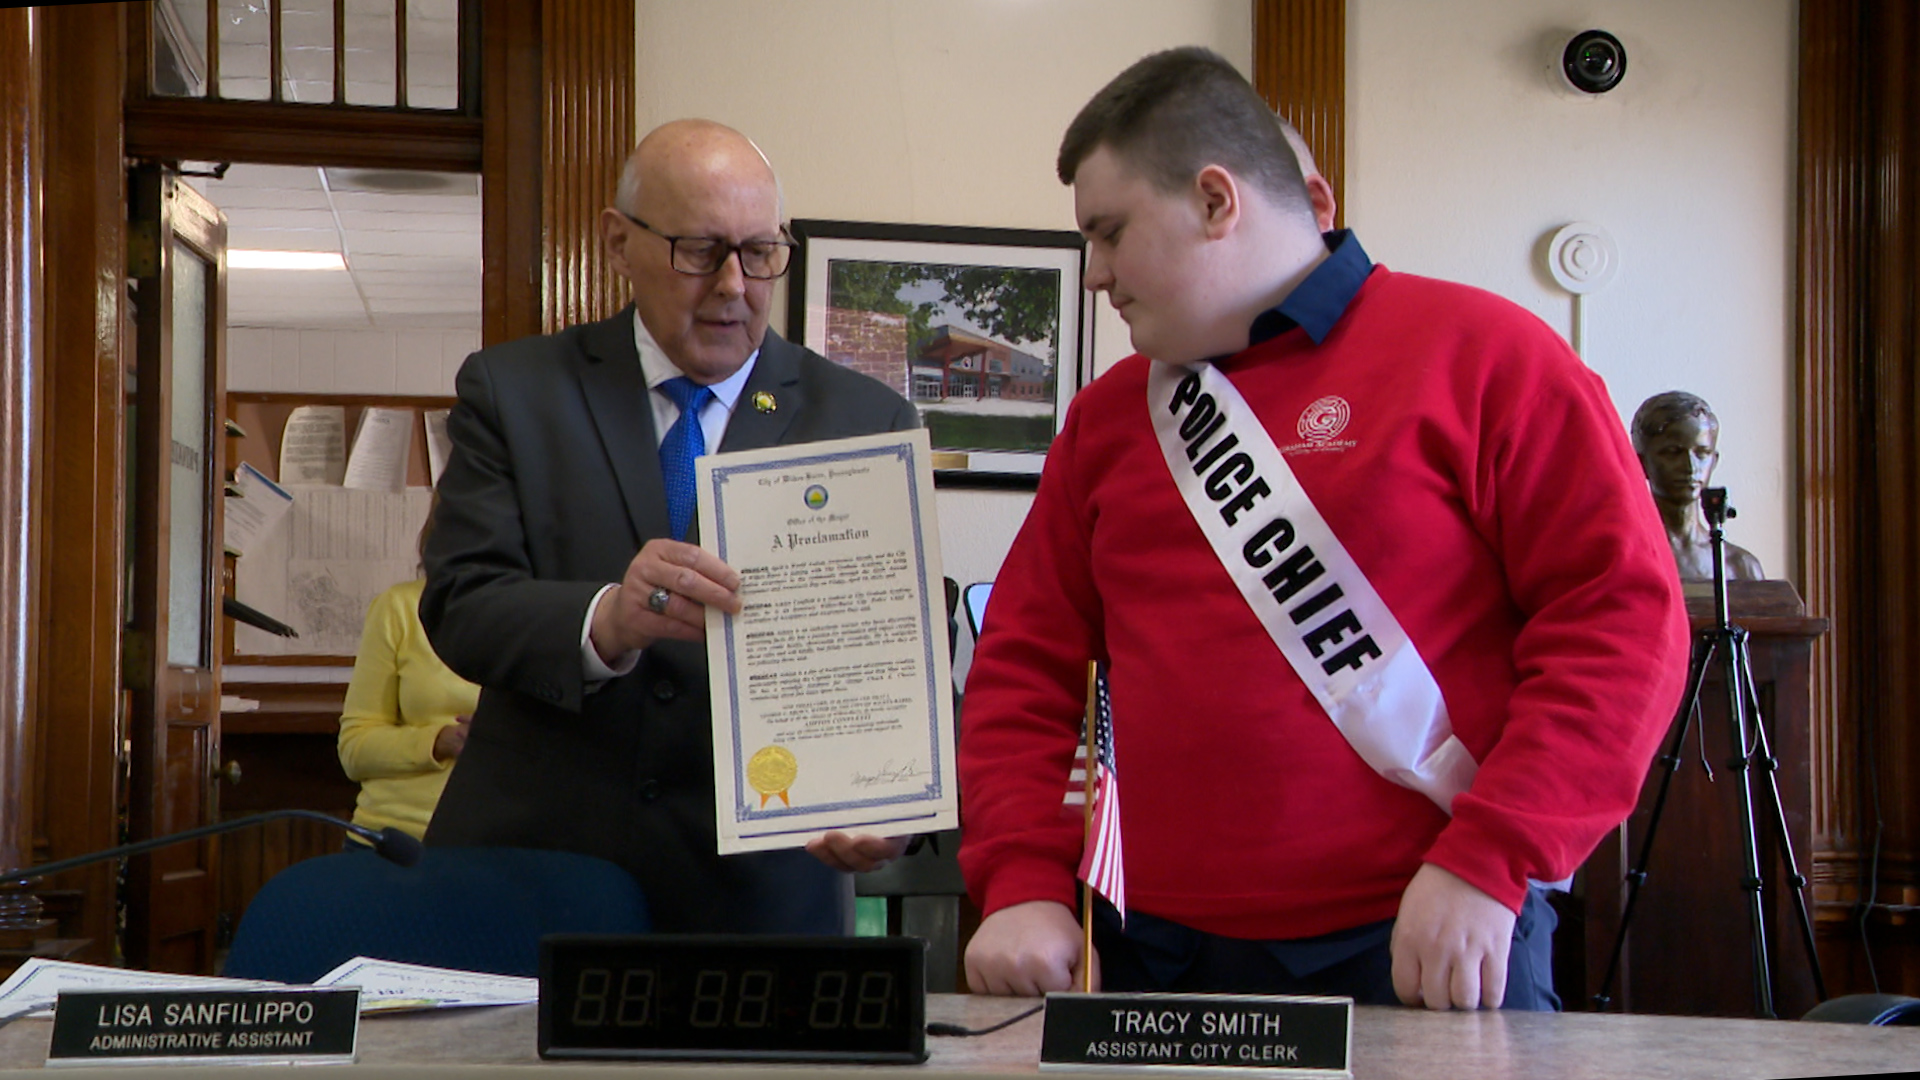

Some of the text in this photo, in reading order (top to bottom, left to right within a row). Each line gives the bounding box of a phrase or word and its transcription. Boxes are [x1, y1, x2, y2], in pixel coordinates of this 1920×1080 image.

[1168, 372, 1271, 528] POLICE
[1242, 517, 1383, 677] CHIEF
[771, 528, 870, 553] A Proclamation
[98, 1001, 314, 1027] LISA SANFILIPPO
[1110, 1009, 1281, 1036] TRACY SMITH
[89, 1031, 314, 1050] ADMINISTRATIVE ASSISTANT
[1085, 1041, 1299, 1061] ASSISTANT CITY CLERK
